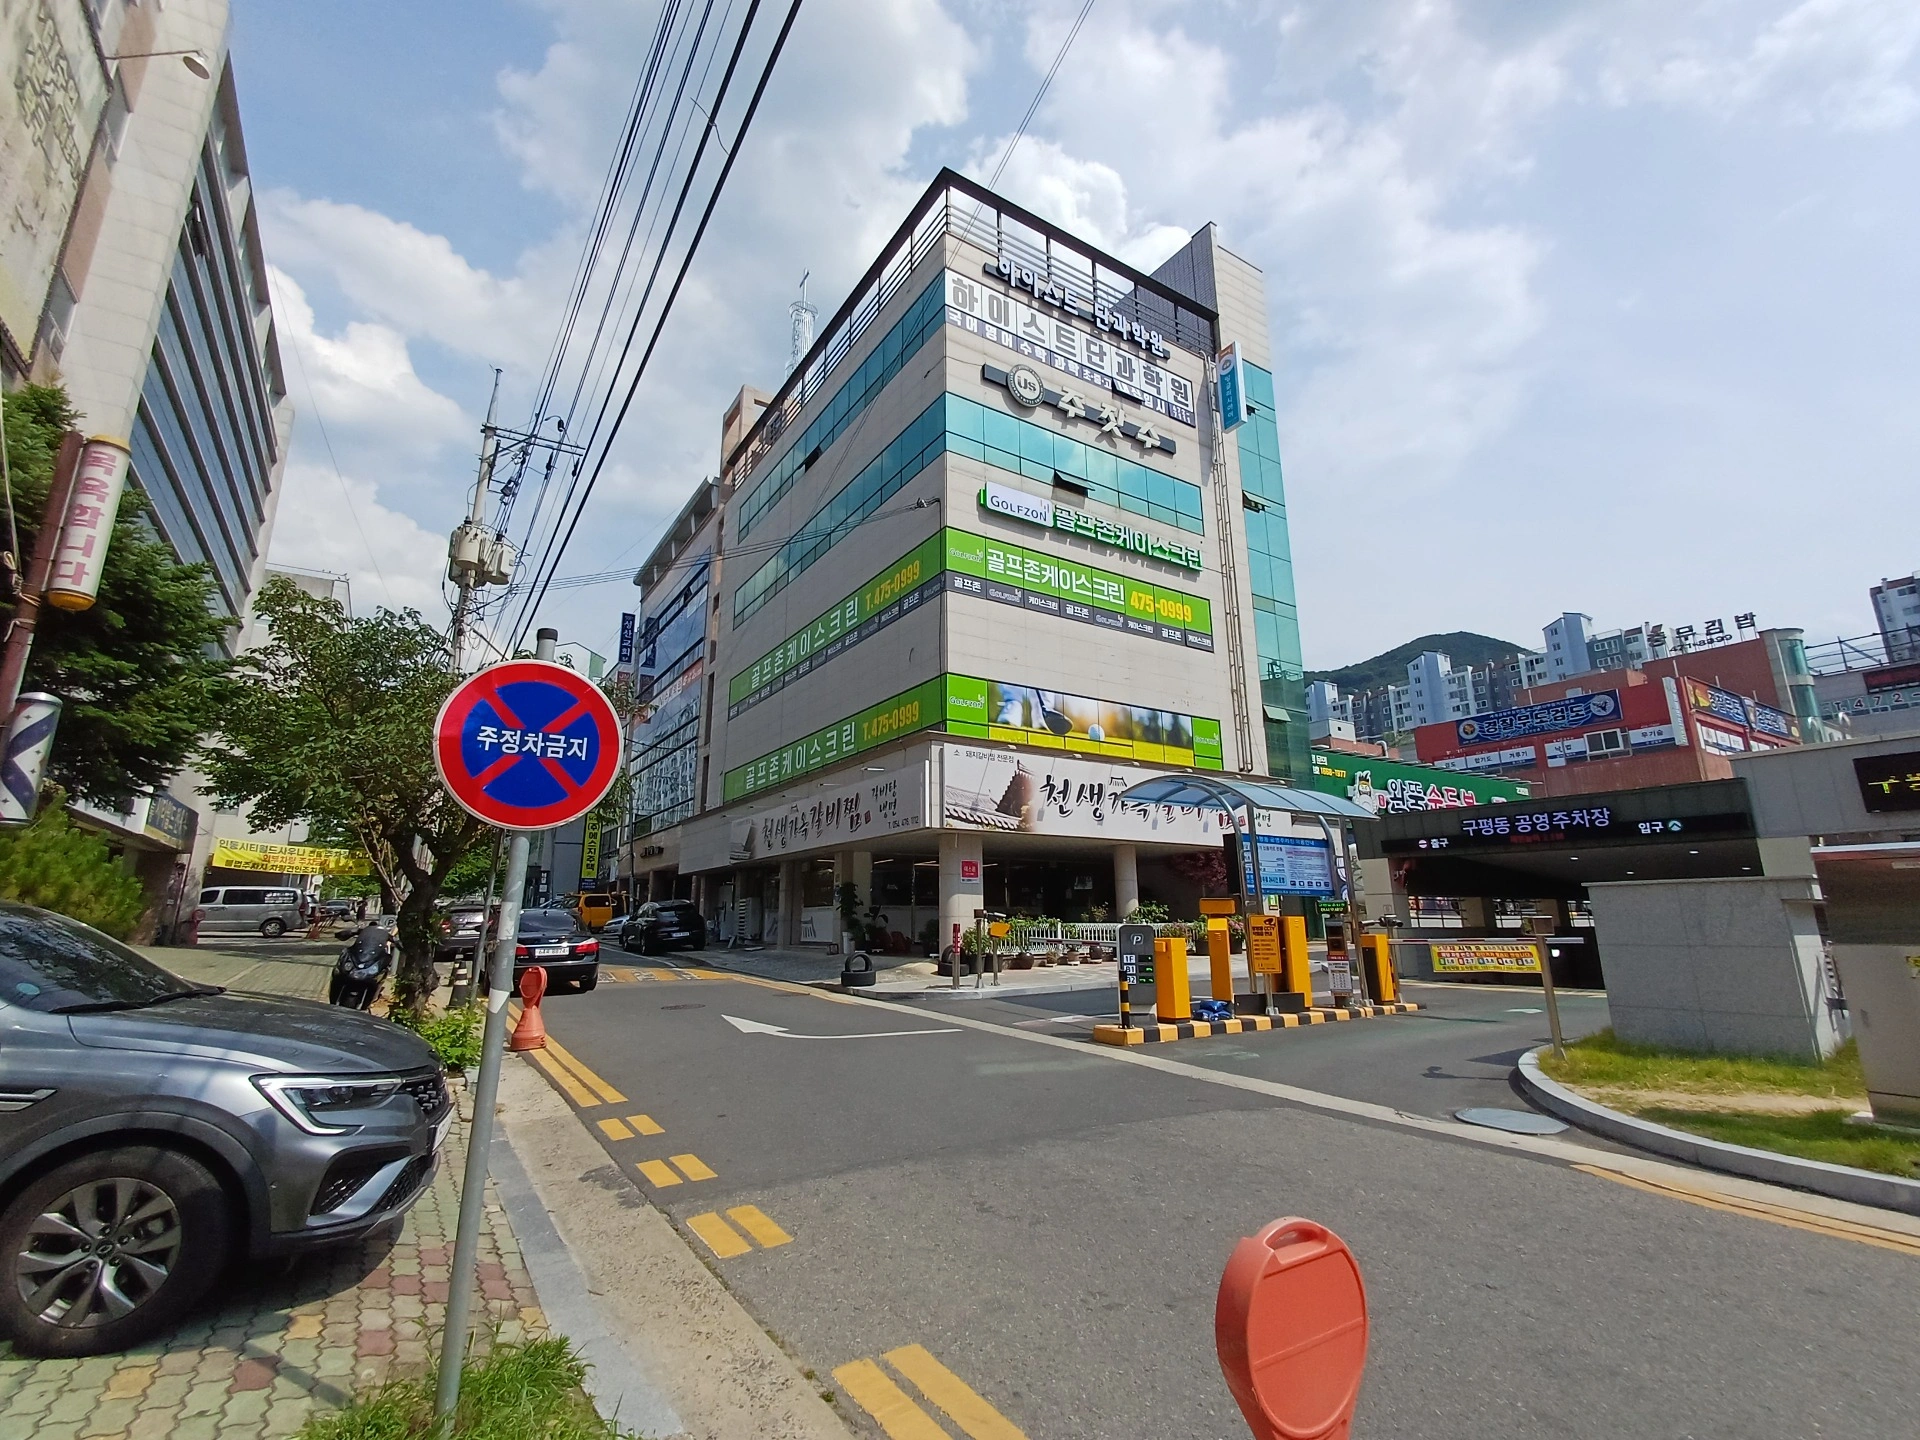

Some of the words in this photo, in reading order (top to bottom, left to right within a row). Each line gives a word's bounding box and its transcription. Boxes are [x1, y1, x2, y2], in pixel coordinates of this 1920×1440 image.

[997, 255, 1079, 317] 하이스트
[1093, 301, 1165, 359] 단과학원
[948, 308, 979, 334] 국어
[984, 322, 1013, 349] 영어
[1020, 342, 1048, 363] 수학
[1054, 355, 1080, 377] 과학
[951, 277, 1190, 404] 하이스트단과학원
[989, 494, 1048, 523] GOLFZON
[1053, 504, 1203, 570] 골프존케이스크린
[949, 547, 983, 564] GOLFZON
[903, 592, 920, 611] 골프존
[986, 547, 1125, 606] 골프존케이스크린
[1129, 590, 1193, 623] 475-0999
[953, 576, 982, 593] 골프존
[1065, 603, 1090, 619] 골프존
[1161, 627, 1182, 641] 골프존
[751, 597, 858, 689] 골프존케이스크린
[949, 694, 985, 710] GOLFZON
[1484, 703, 1586, 734] 경찰무도검도
[476, 725, 588, 761] 주정차금지
[745, 721, 856, 790] 골프존케이스크린
[871, 779, 898, 801] 갈비탕
[1461, 818, 1511, 837] 구평동
[1514, 807, 1611, 833] 공영주차장
[1638, 821, 1665, 835] 입구
[1430, 838, 1450, 849] 출구
